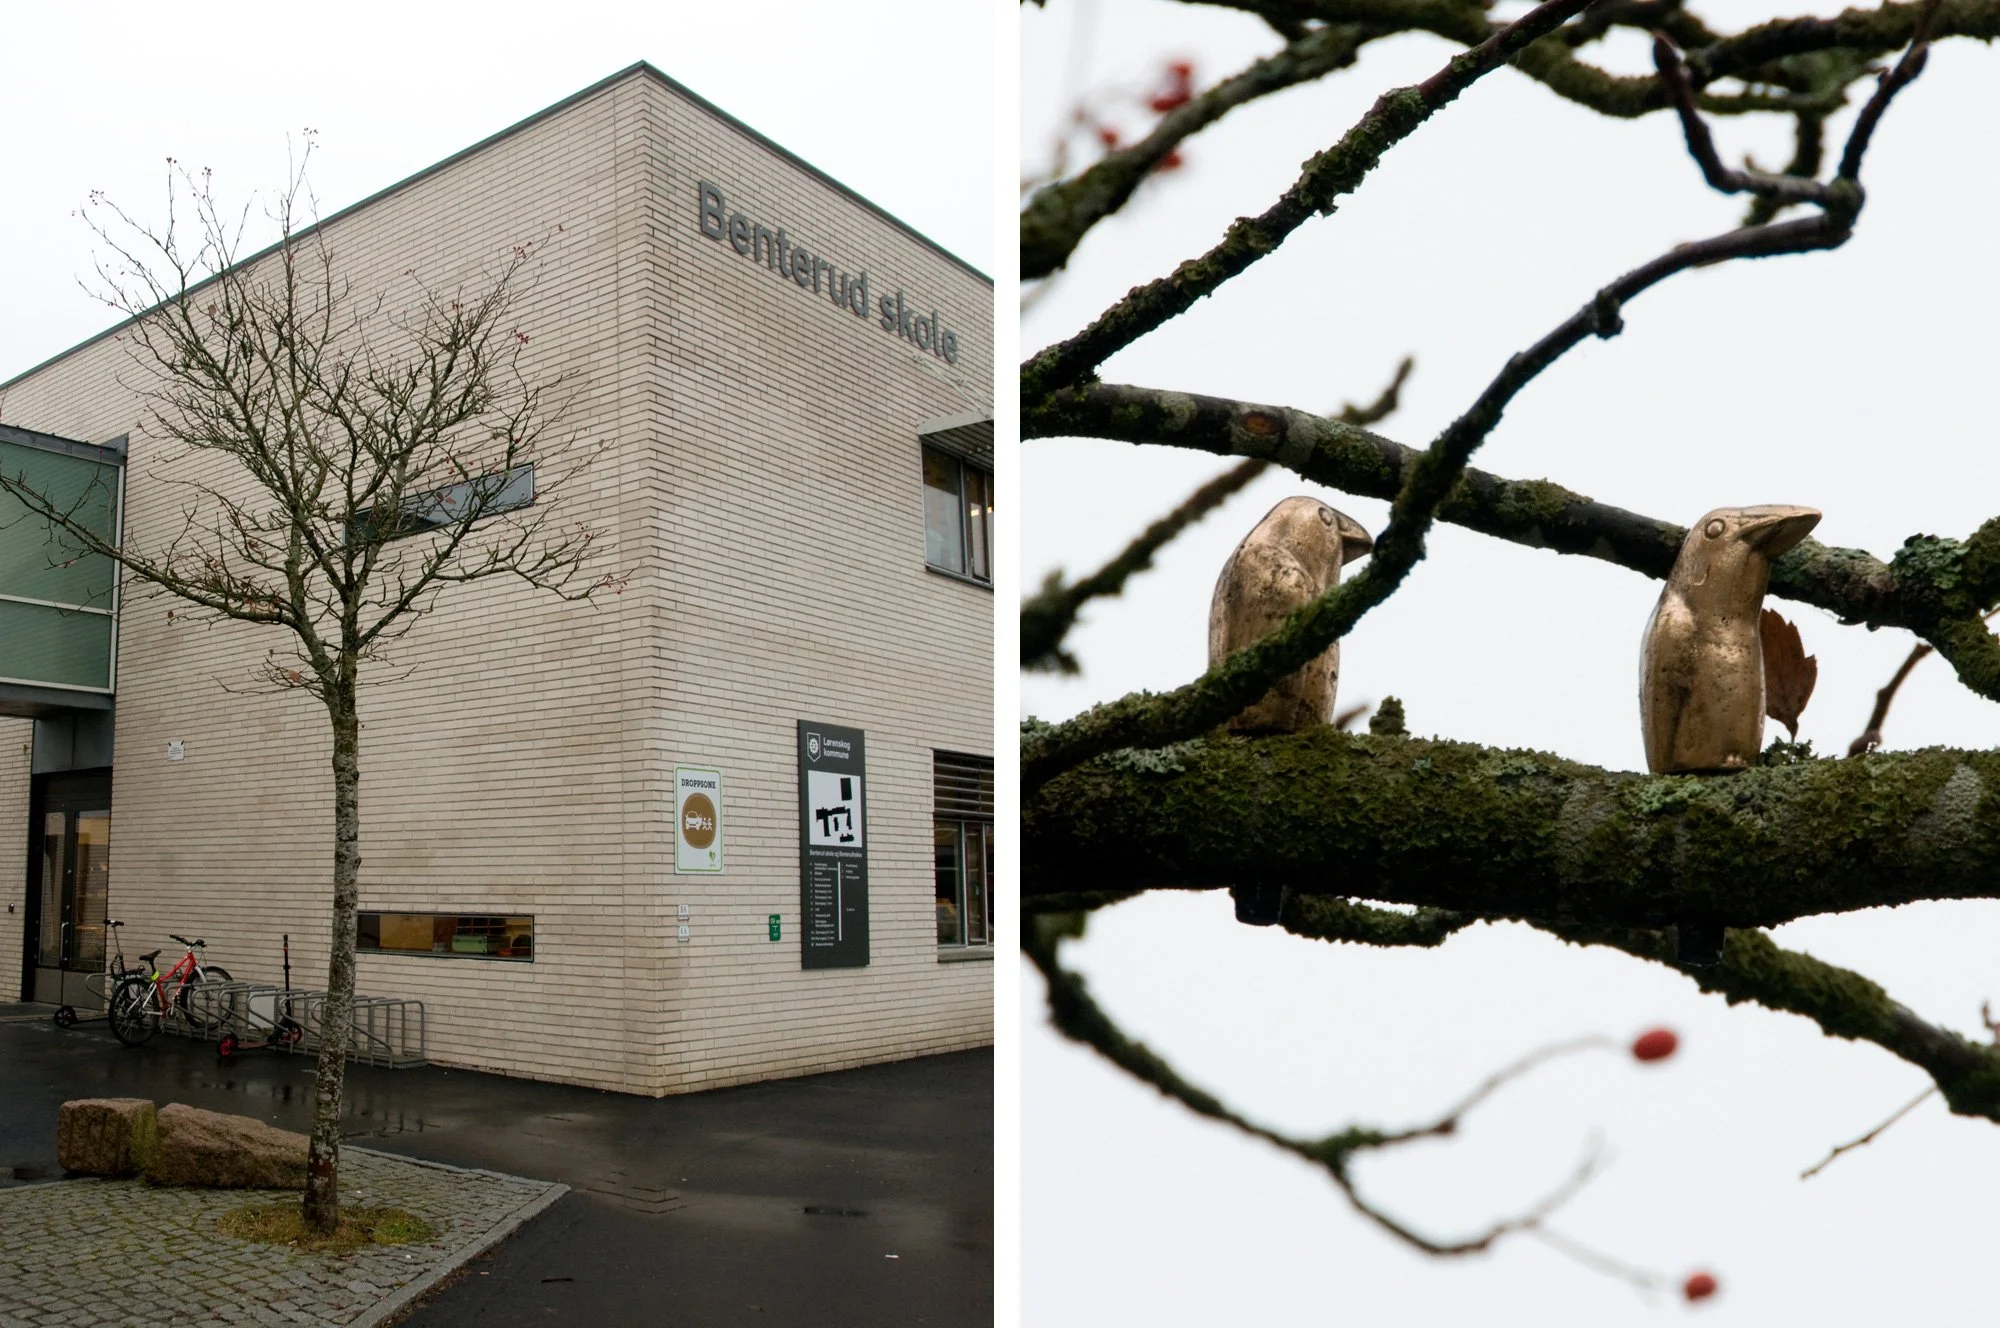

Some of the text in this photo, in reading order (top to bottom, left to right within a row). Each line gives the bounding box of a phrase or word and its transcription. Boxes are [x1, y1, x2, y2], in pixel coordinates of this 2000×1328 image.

[699, 179, 958, 364] Benterud skole
[823, 736, 851, 751] Lørenskog
[823, 747, 850, 760] kommune
[681, 778, 716, 789] DROPPSONE
